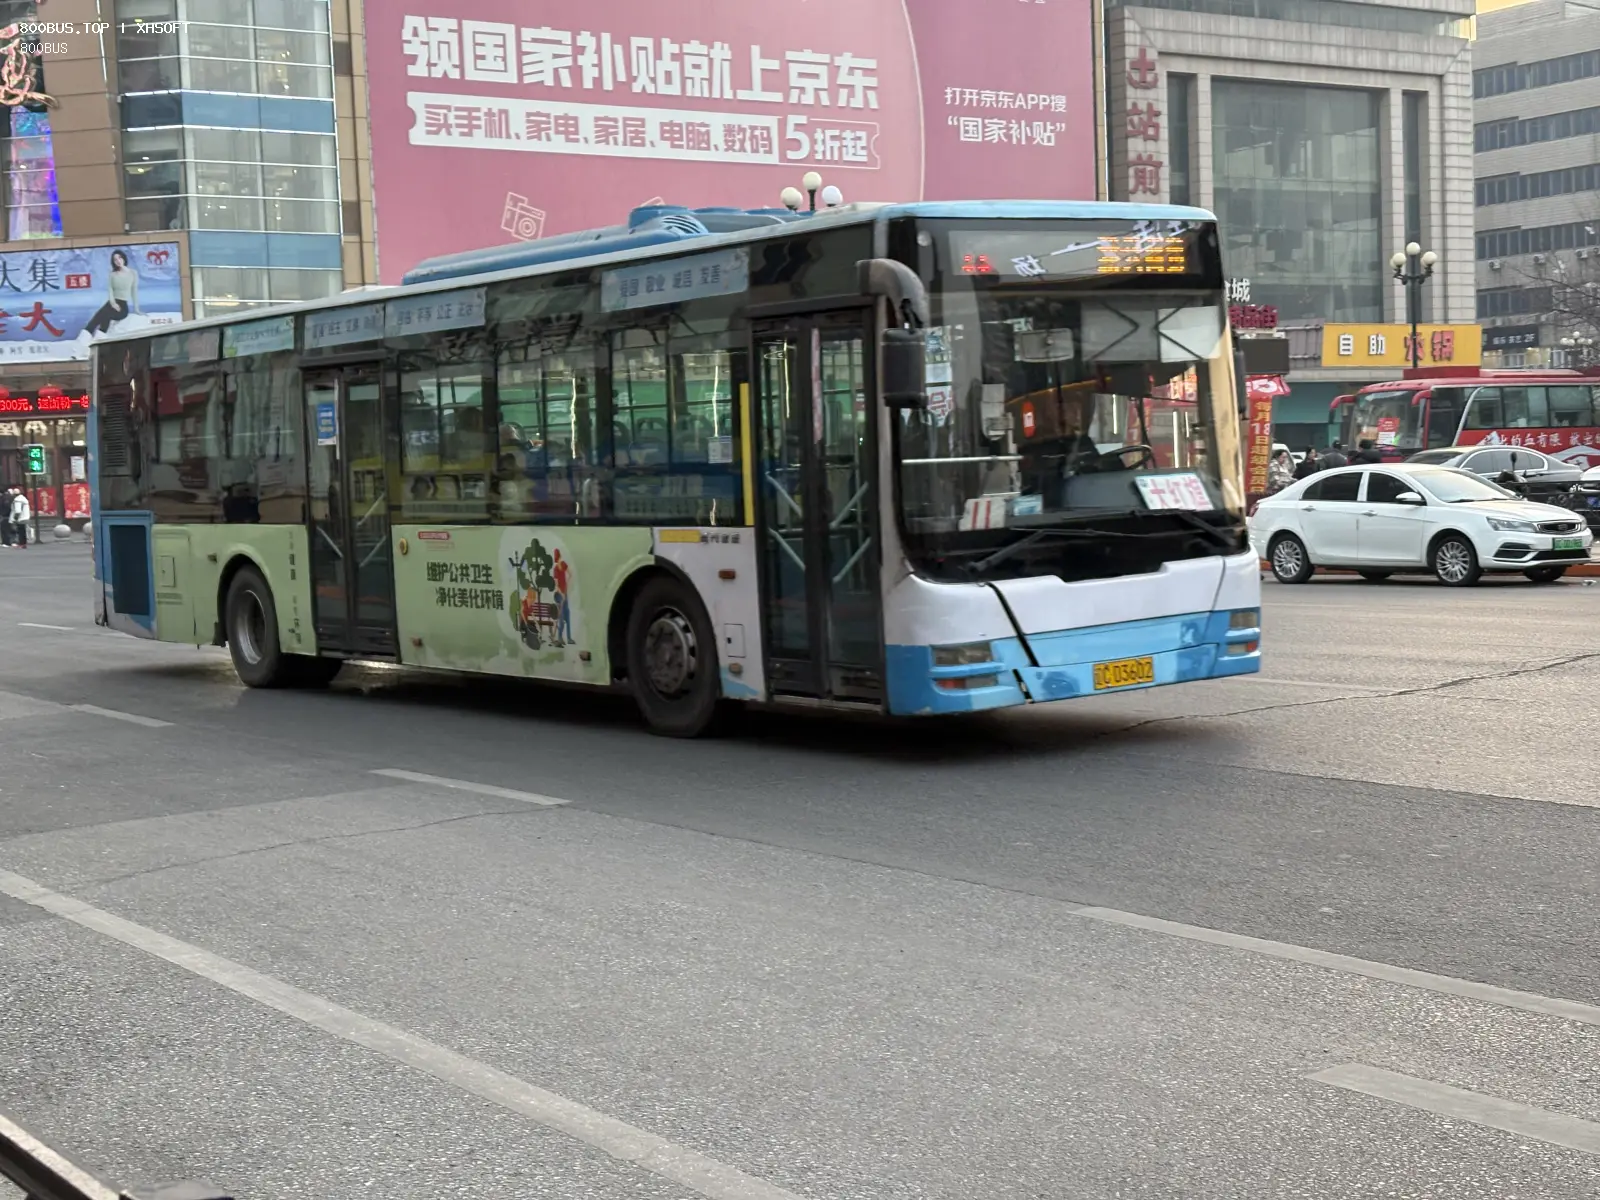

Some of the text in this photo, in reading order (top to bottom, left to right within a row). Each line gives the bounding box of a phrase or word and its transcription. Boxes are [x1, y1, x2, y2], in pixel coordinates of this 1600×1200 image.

[402, 15, 879, 109] 领国家补贴就上京东
[944, 87, 1067, 113] 打开京东APP搜
[785, 115, 869, 163] 5折起
[426, 562, 494, 584] 维护公共卫生
[435, 586, 504, 610] 净化美化环境
